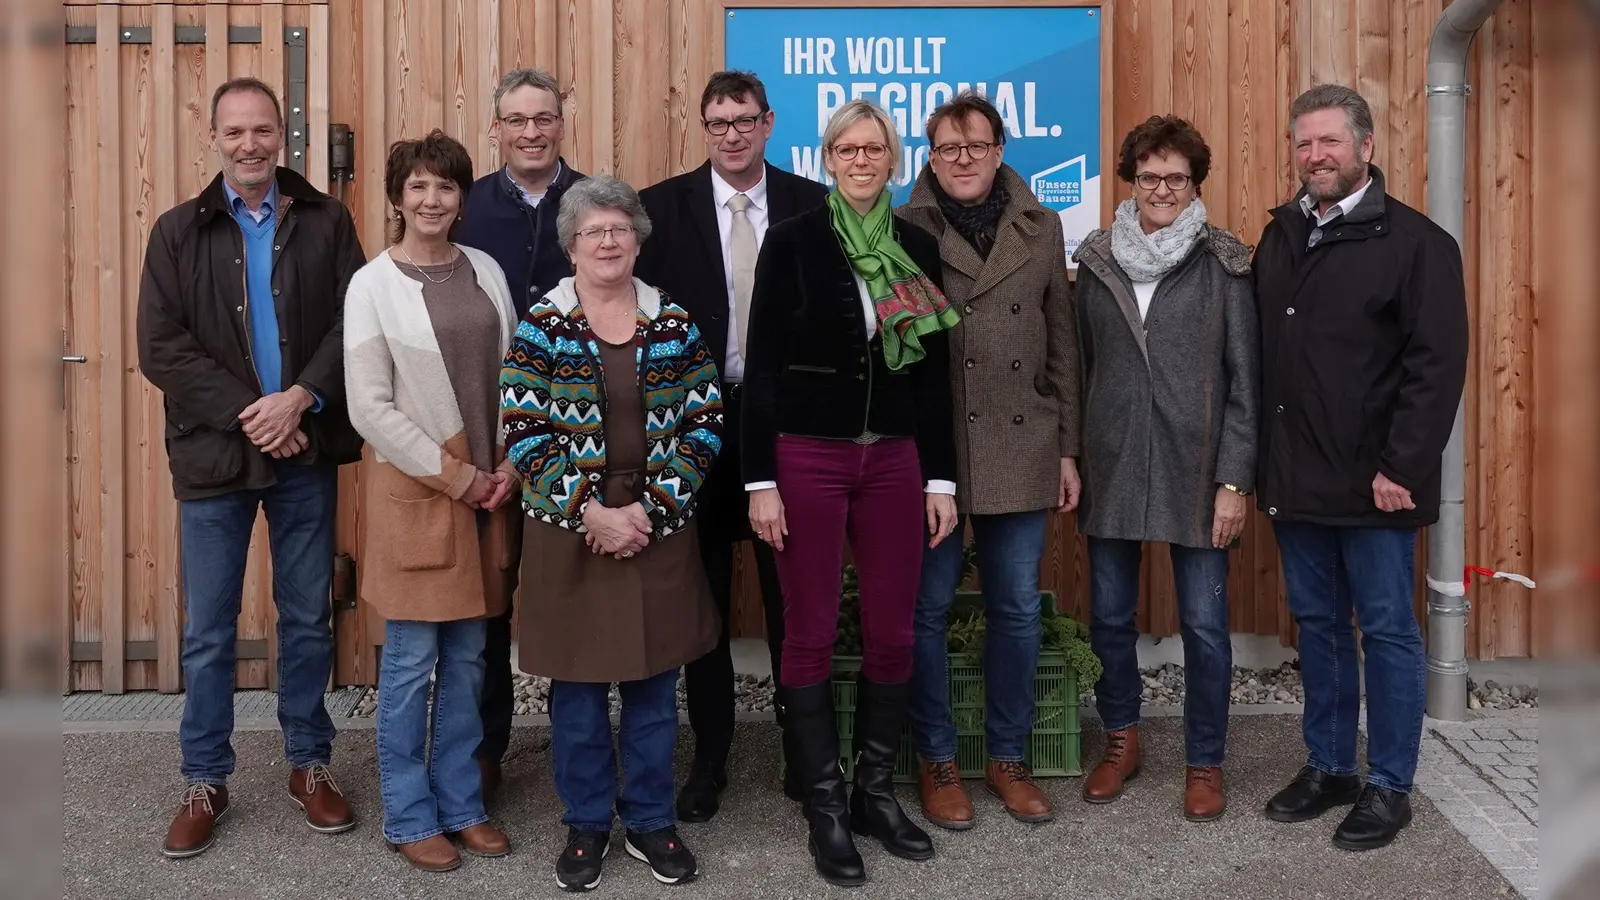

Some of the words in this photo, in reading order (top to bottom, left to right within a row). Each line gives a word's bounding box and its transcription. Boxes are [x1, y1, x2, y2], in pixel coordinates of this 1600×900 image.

[784, 37, 838, 75] IHR
[846, 37, 947, 75] WOLLT
[817, 81, 1063, 138] RGIAL.
[1037, 179, 1079, 189] Unsere
[1037, 194, 1081, 203] Bauern
